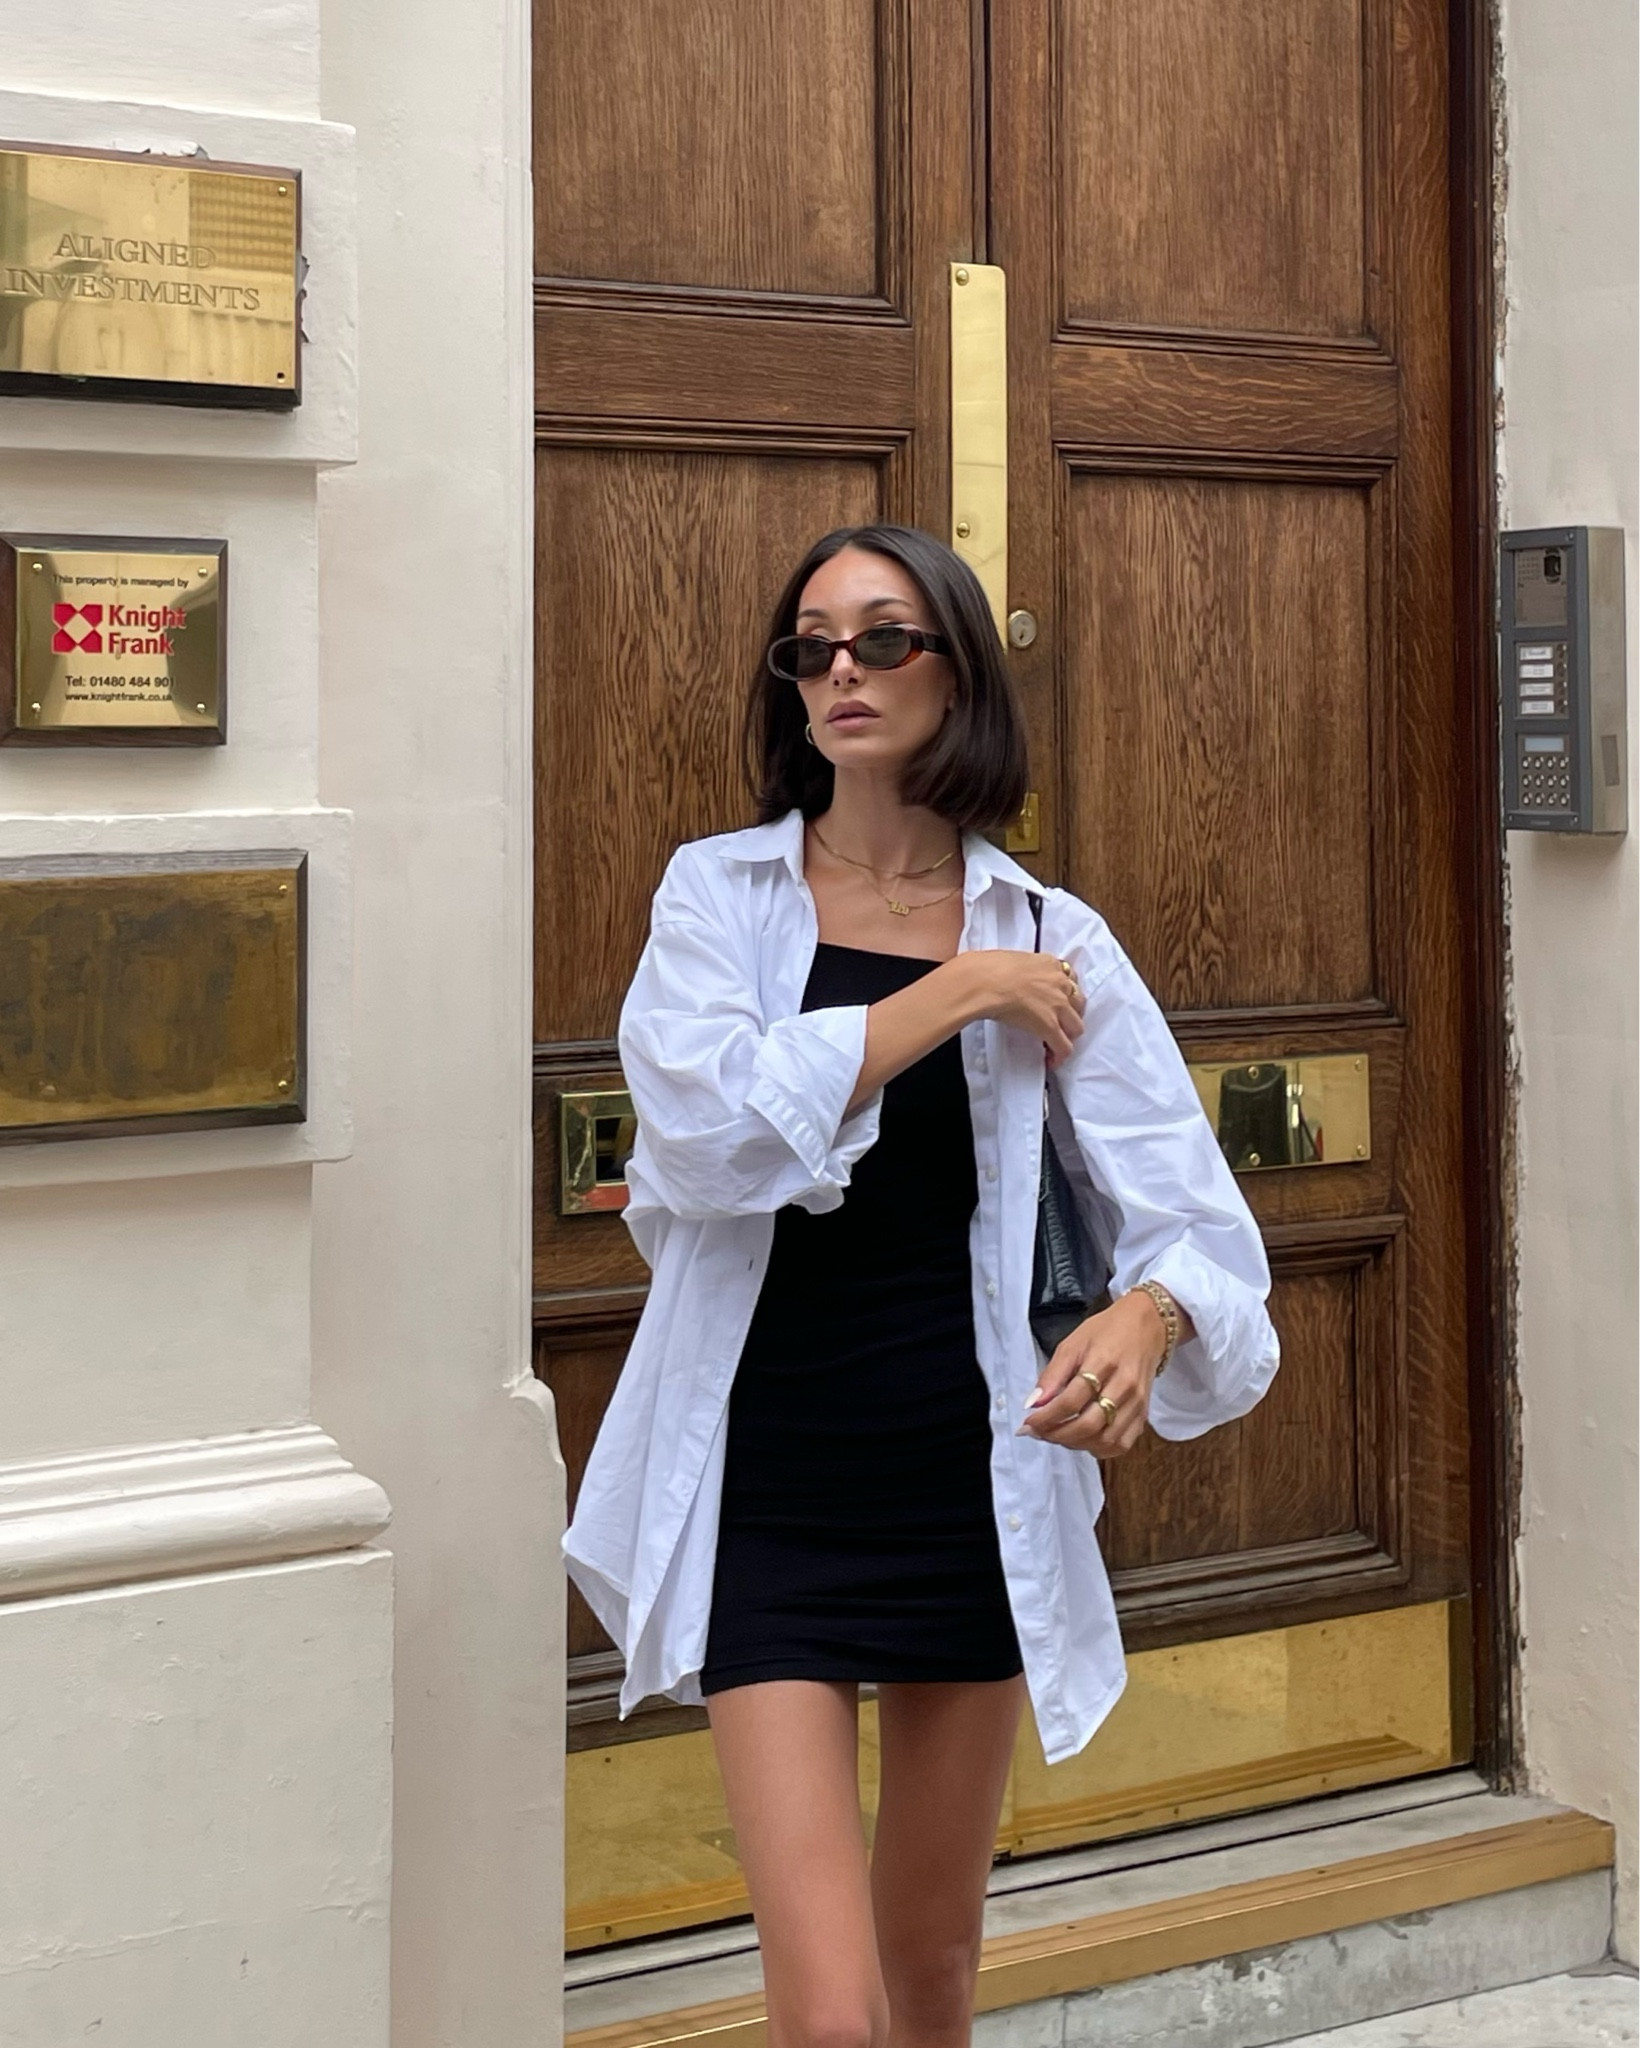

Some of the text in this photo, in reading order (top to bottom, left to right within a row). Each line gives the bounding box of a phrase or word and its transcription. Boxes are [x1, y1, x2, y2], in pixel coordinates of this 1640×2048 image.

[53, 232, 216, 268] ALIGNED
[4, 268, 260, 311] INVESTMENTS
[54, 574, 189, 589] This property is managed by
[108, 604, 186, 633] Knight
[108, 632, 175, 655] Frank
[65, 675, 86, 688] Tel:
[89, 676, 126, 688] 01480
[129, 676, 151, 688] 484
